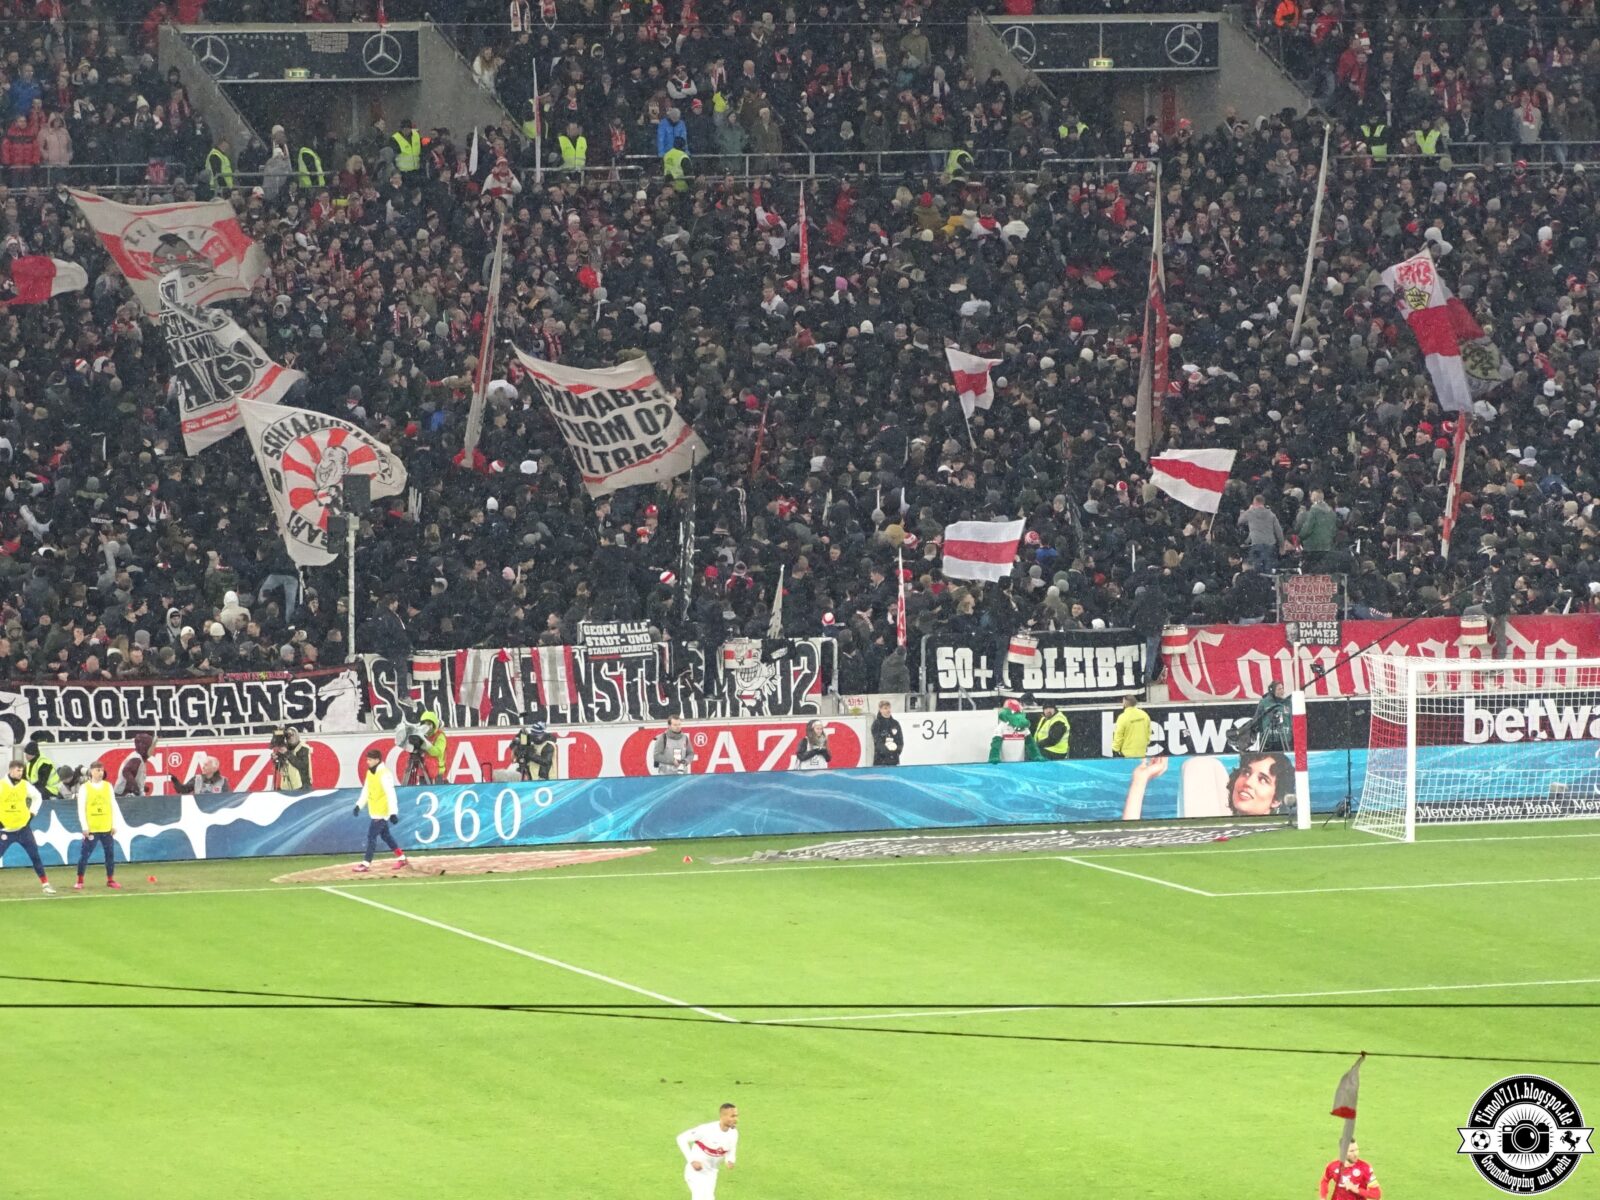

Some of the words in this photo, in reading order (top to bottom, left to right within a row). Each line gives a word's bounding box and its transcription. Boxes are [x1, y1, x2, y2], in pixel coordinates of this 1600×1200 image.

[583, 624, 618, 635] GEGEN
[620, 621, 649, 634] ALLE
[1300, 629, 1338, 637] IMMER
[627, 633, 651, 644] UND
[22, 679, 316, 727] HOOLIGANS
[415, 787, 553, 844] 360°
[1416, 803, 1523, 818] Mercedes-Benz
[1525, 801, 1562, 815] Bank
